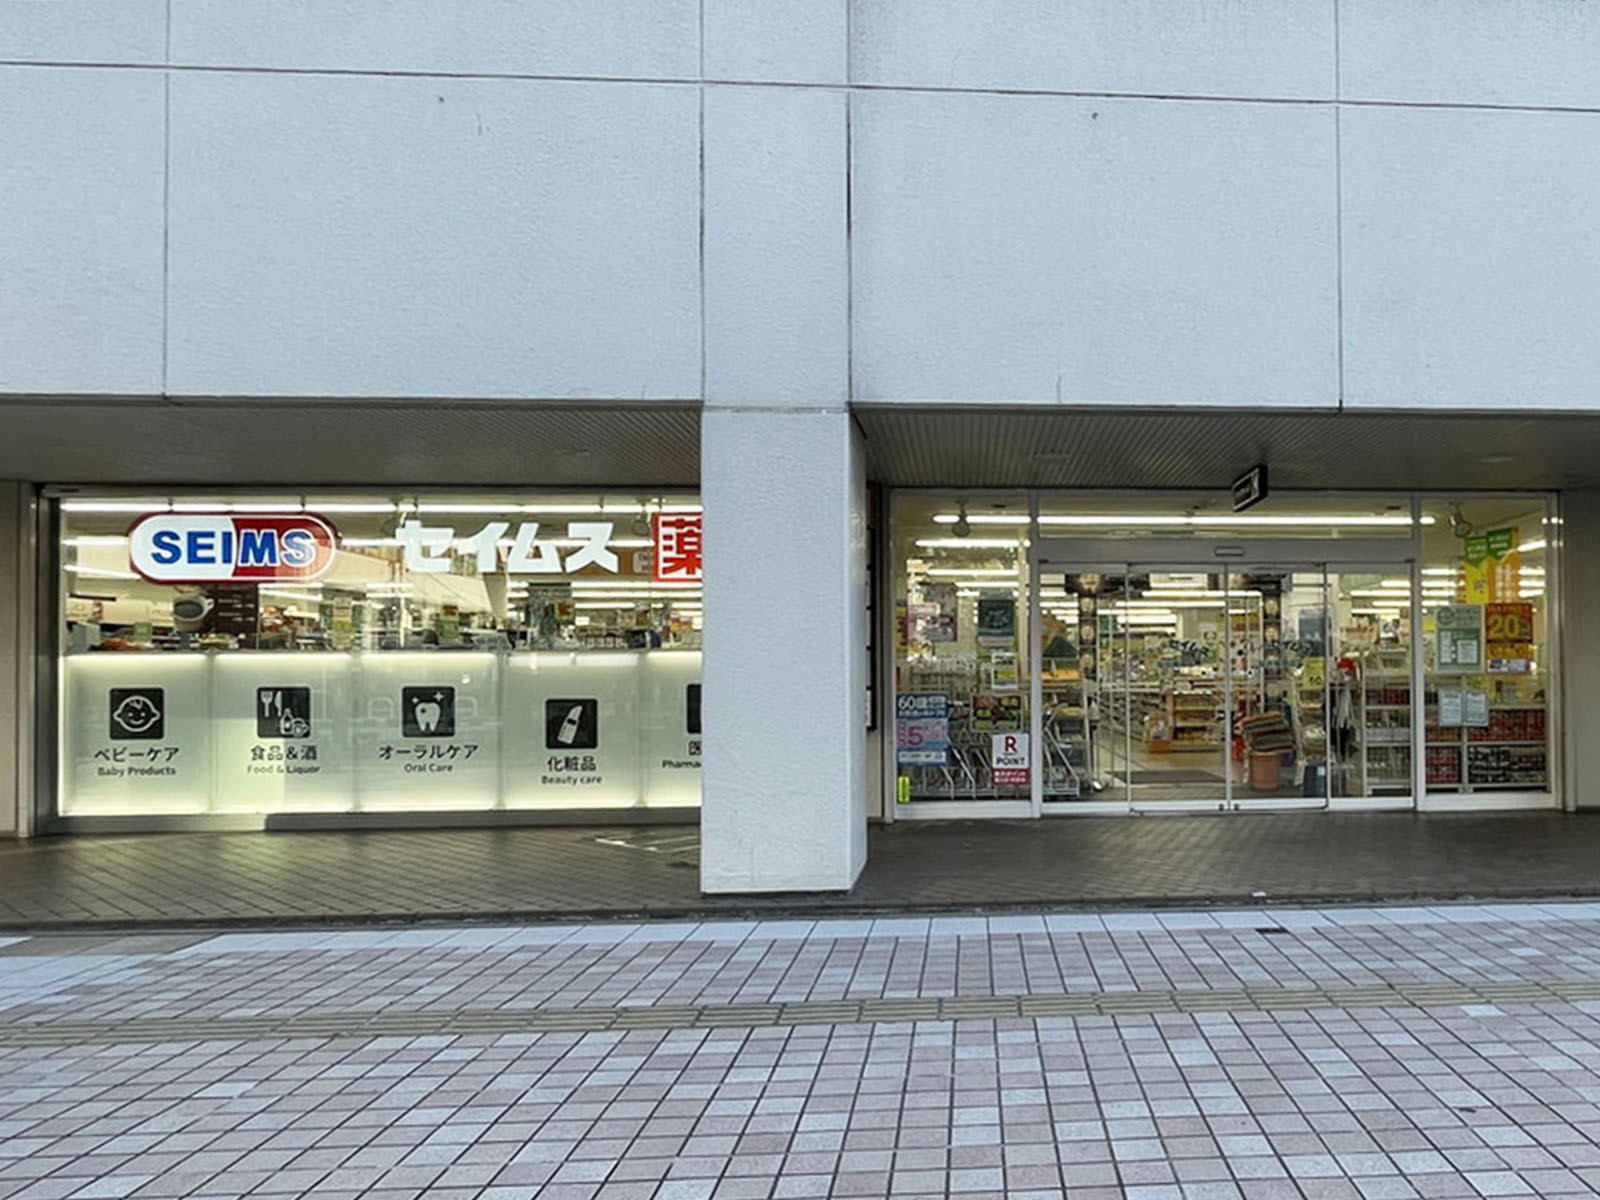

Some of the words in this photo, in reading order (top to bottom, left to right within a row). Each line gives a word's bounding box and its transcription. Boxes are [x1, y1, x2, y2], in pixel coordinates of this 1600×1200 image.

[151, 530, 316, 566] SEIMS
[395, 519, 619, 573] セイムス
[379, 744, 479, 760] オーラルケア
[1004, 735, 1018, 753] R
[94, 746, 180, 762] ベビーケア
[996, 757, 1026, 766] POINT
[97, 766, 125, 777] Baby
[127, 766, 176, 776] Products
[248, 765, 273, 774] Food
[276, 765, 284, 773] &
[286, 765, 321, 775] Liquor
[404, 763, 427, 772] Oral
[429, 763, 453, 773] Care
[547, 756, 597, 772] 化粧品
[541, 775, 579, 787] Beauty
[580, 776, 603, 785] care
